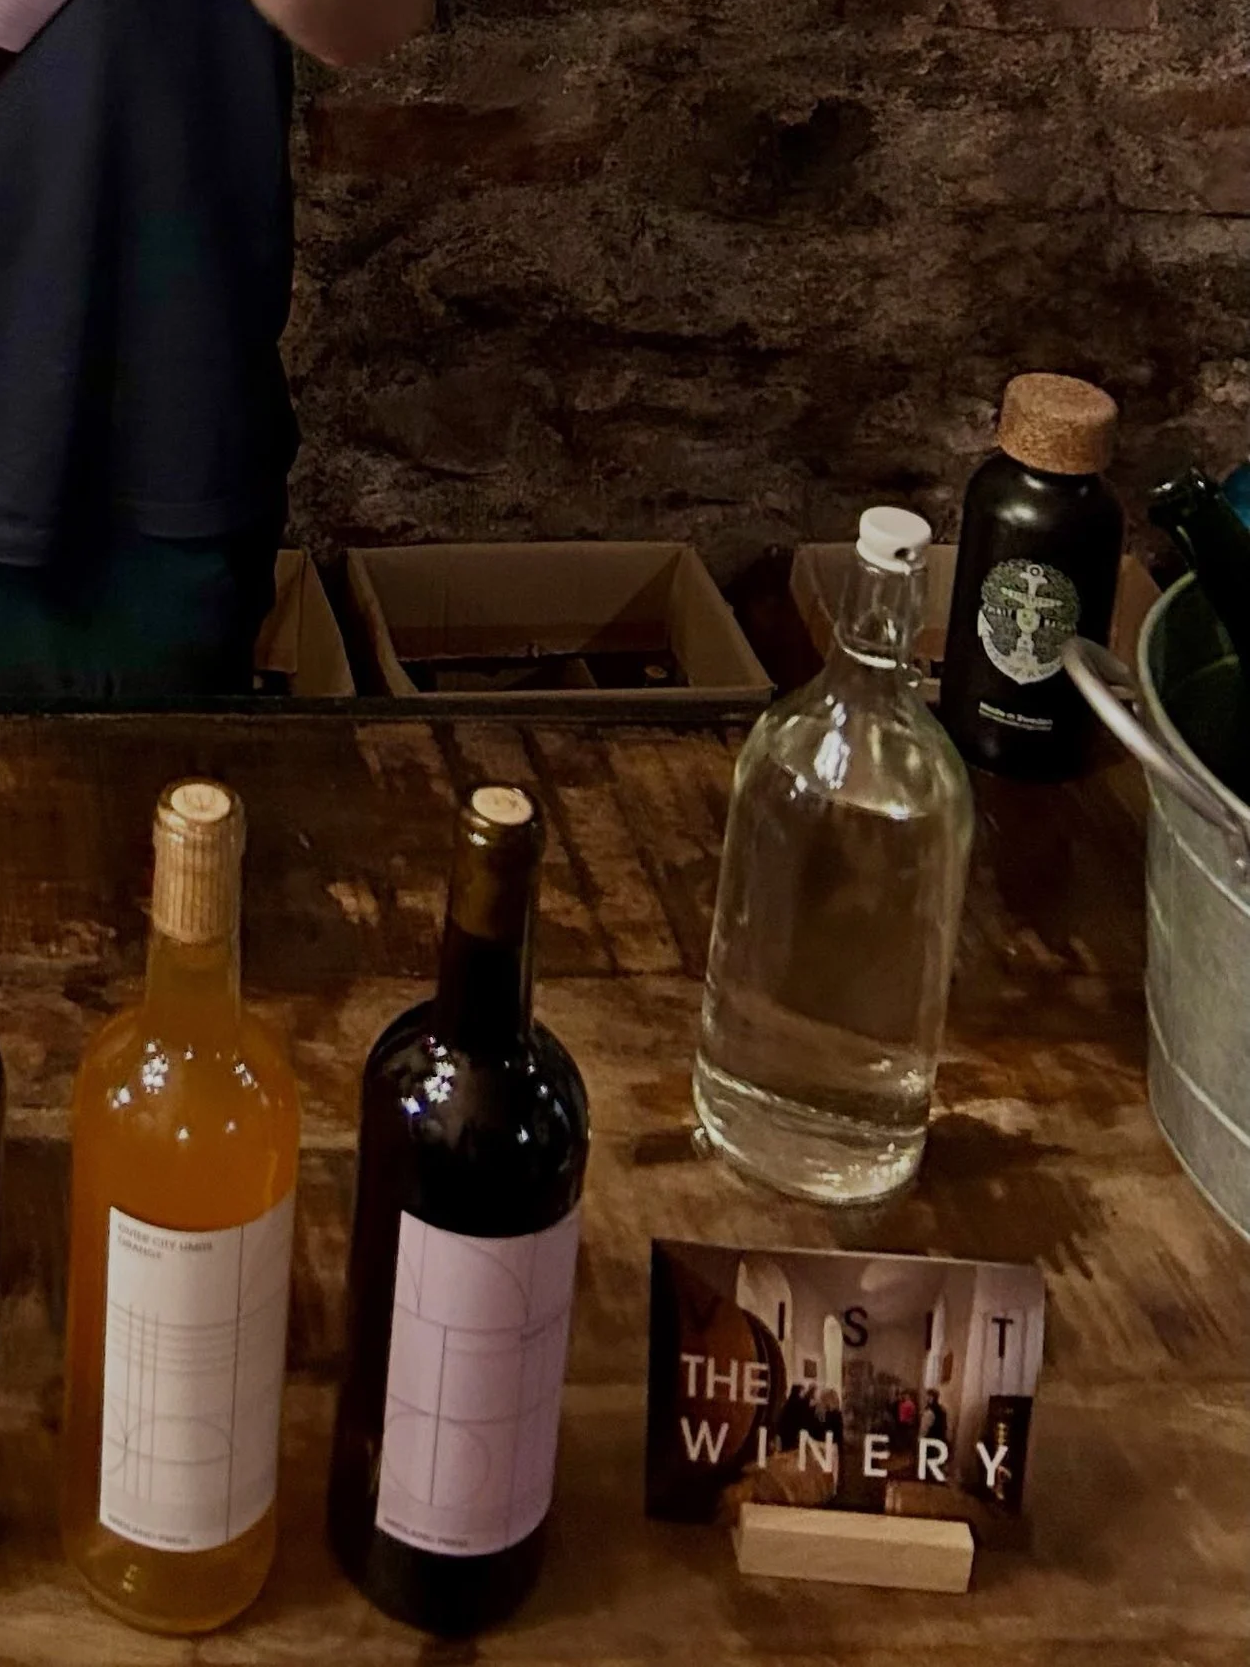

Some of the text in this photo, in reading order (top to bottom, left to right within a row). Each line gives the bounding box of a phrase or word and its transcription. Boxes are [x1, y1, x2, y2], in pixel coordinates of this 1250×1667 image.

[152, 1236, 177, 1251] CITY
[680, 1352, 770, 1406] THE
[680, 1415, 1010, 1489] WINERY
